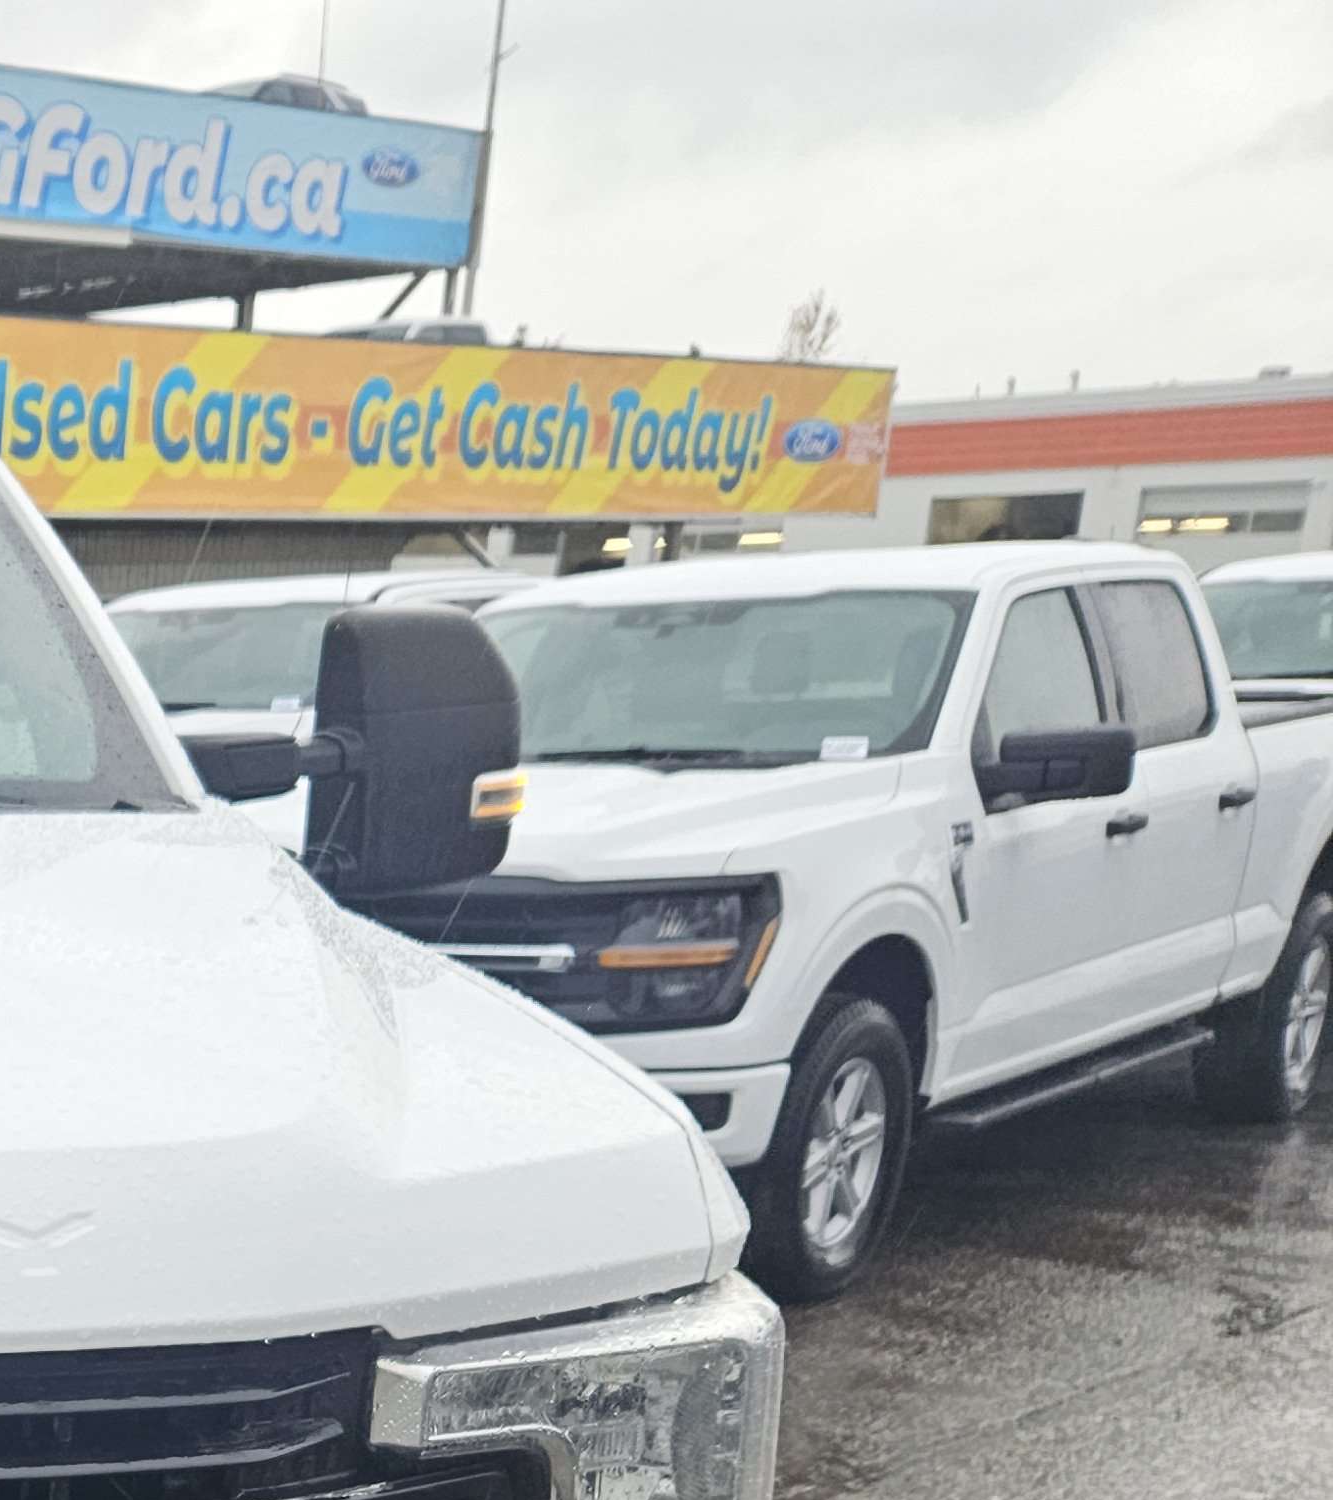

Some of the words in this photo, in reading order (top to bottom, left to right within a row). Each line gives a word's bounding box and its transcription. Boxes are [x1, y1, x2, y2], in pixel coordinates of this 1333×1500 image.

[151, 365, 292, 465] Cars
[348, 376, 445, 467] Get
[459, 381, 589, 470] Cash
[608, 386, 773, 494] Today!
